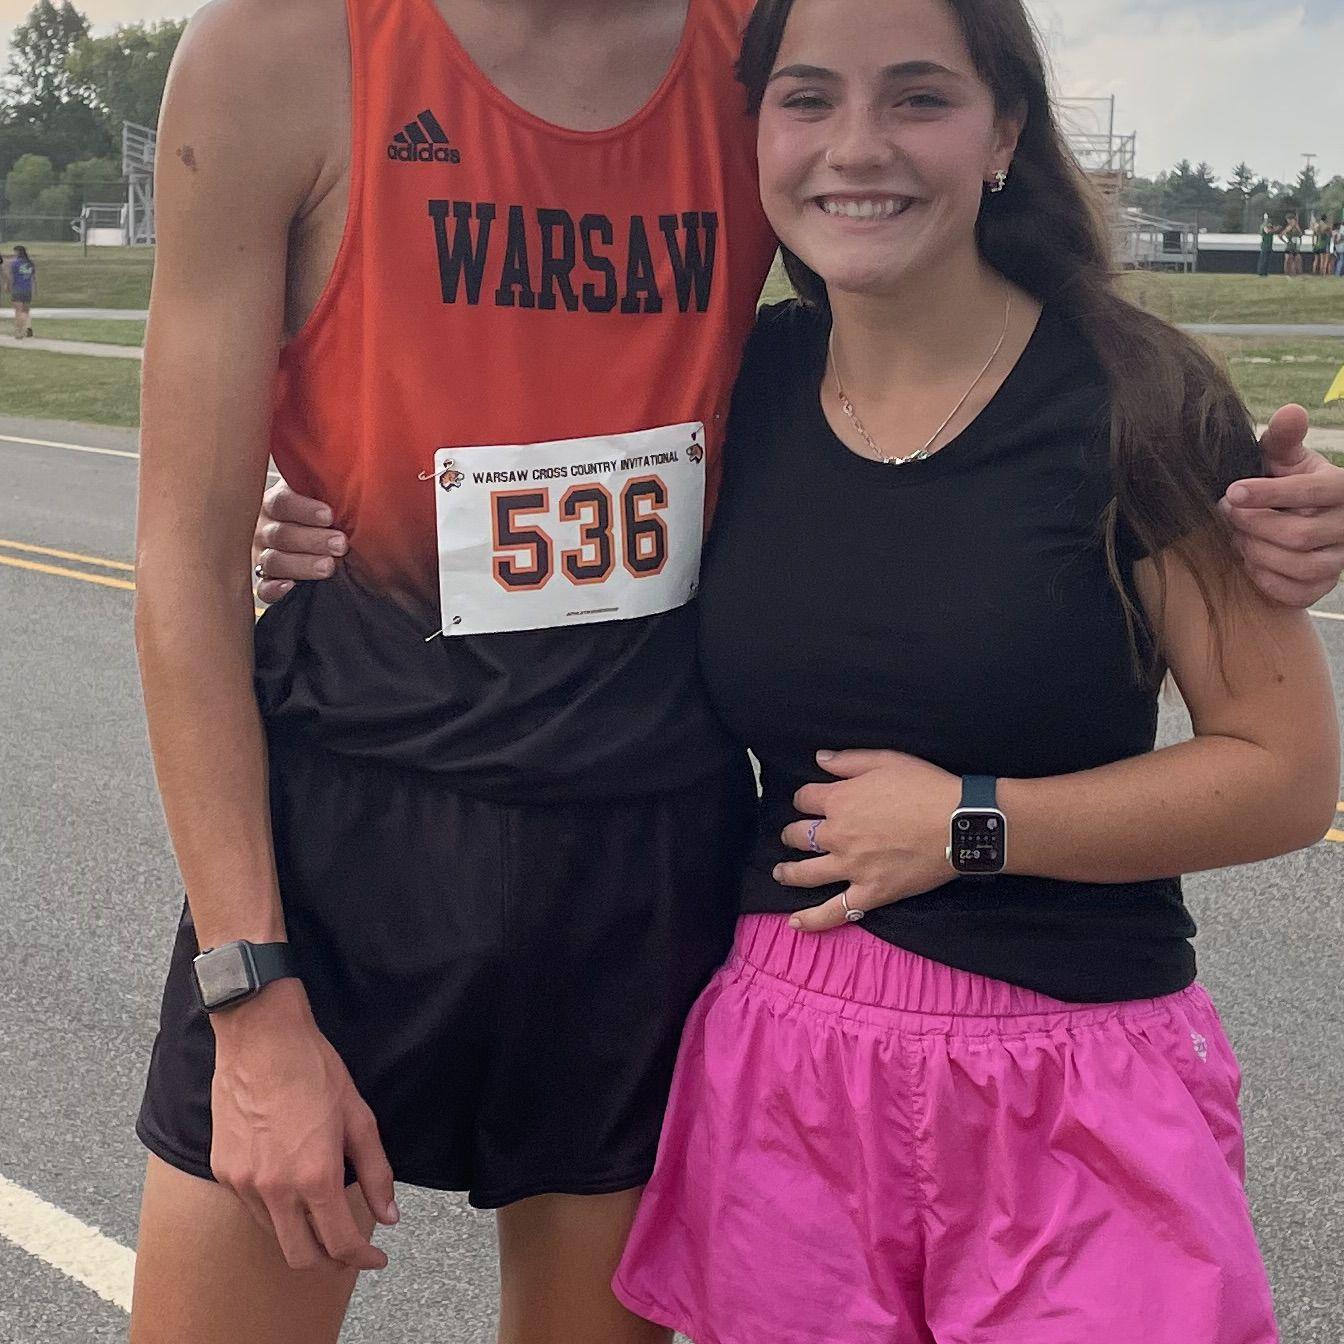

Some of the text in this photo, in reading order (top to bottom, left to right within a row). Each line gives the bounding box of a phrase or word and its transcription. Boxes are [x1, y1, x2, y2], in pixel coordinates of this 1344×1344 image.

[388, 143, 460, 164] adidas
[429, 200, 718, 314] WARSAW
[473, 451, 679, 484] WARSAW CROSS COUNTRY INVITATIONAL
[490, 474, 668, 592] 536
